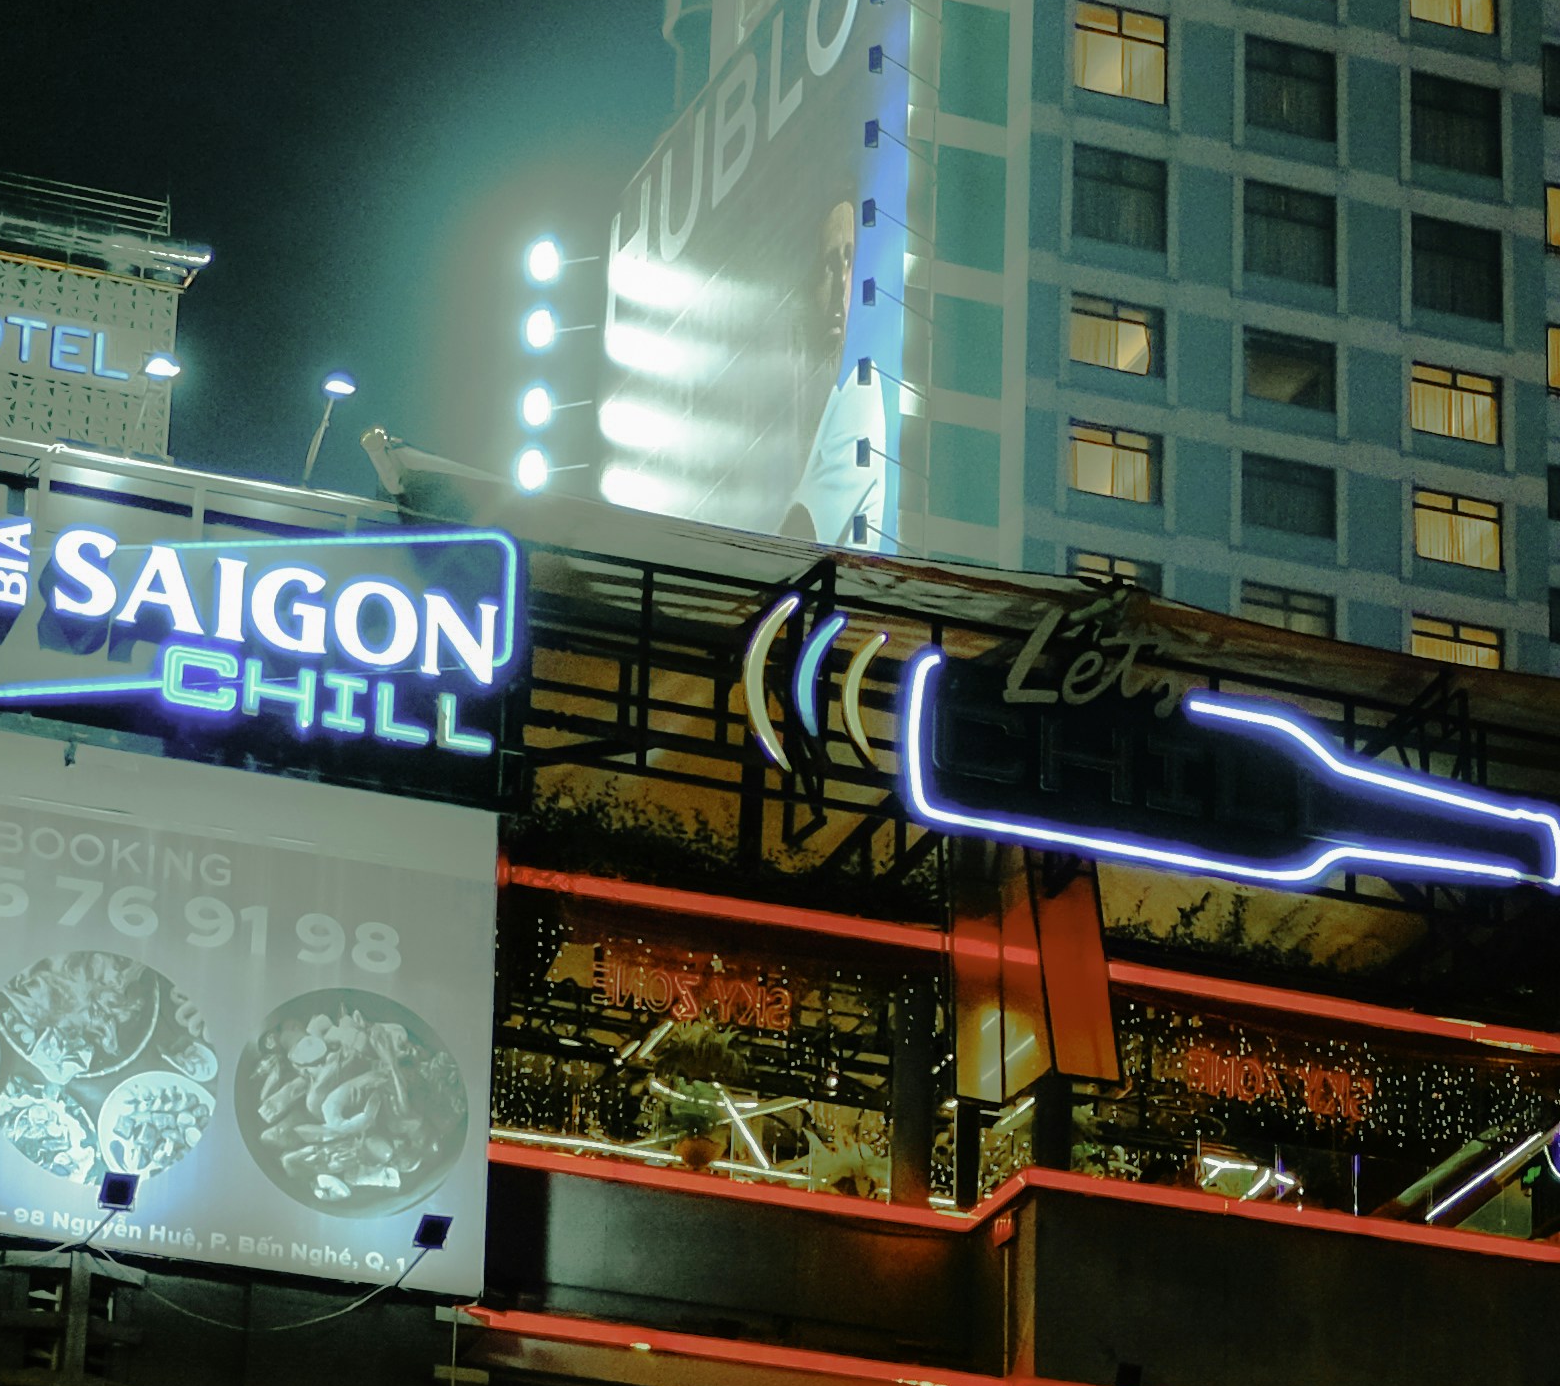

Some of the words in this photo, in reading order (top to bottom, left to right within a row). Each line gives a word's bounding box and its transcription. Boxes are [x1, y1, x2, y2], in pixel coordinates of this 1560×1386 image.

[53, 528, 500, 686] SAIGON
[161, 644, 496, 756] CHILL
[54, 875, 160, 939] 76
[183, 895, 269, 956] 91
[295, 912, 403, 975] 98
[13, 1207, 46, 1226] 98
[210, 1234, 231, 1252] P.
[239, 1231, 284, 1259] Bến
[290, 1241, 359, 1270] Nghé,
[364, 1253, 390, 1273] Q.
